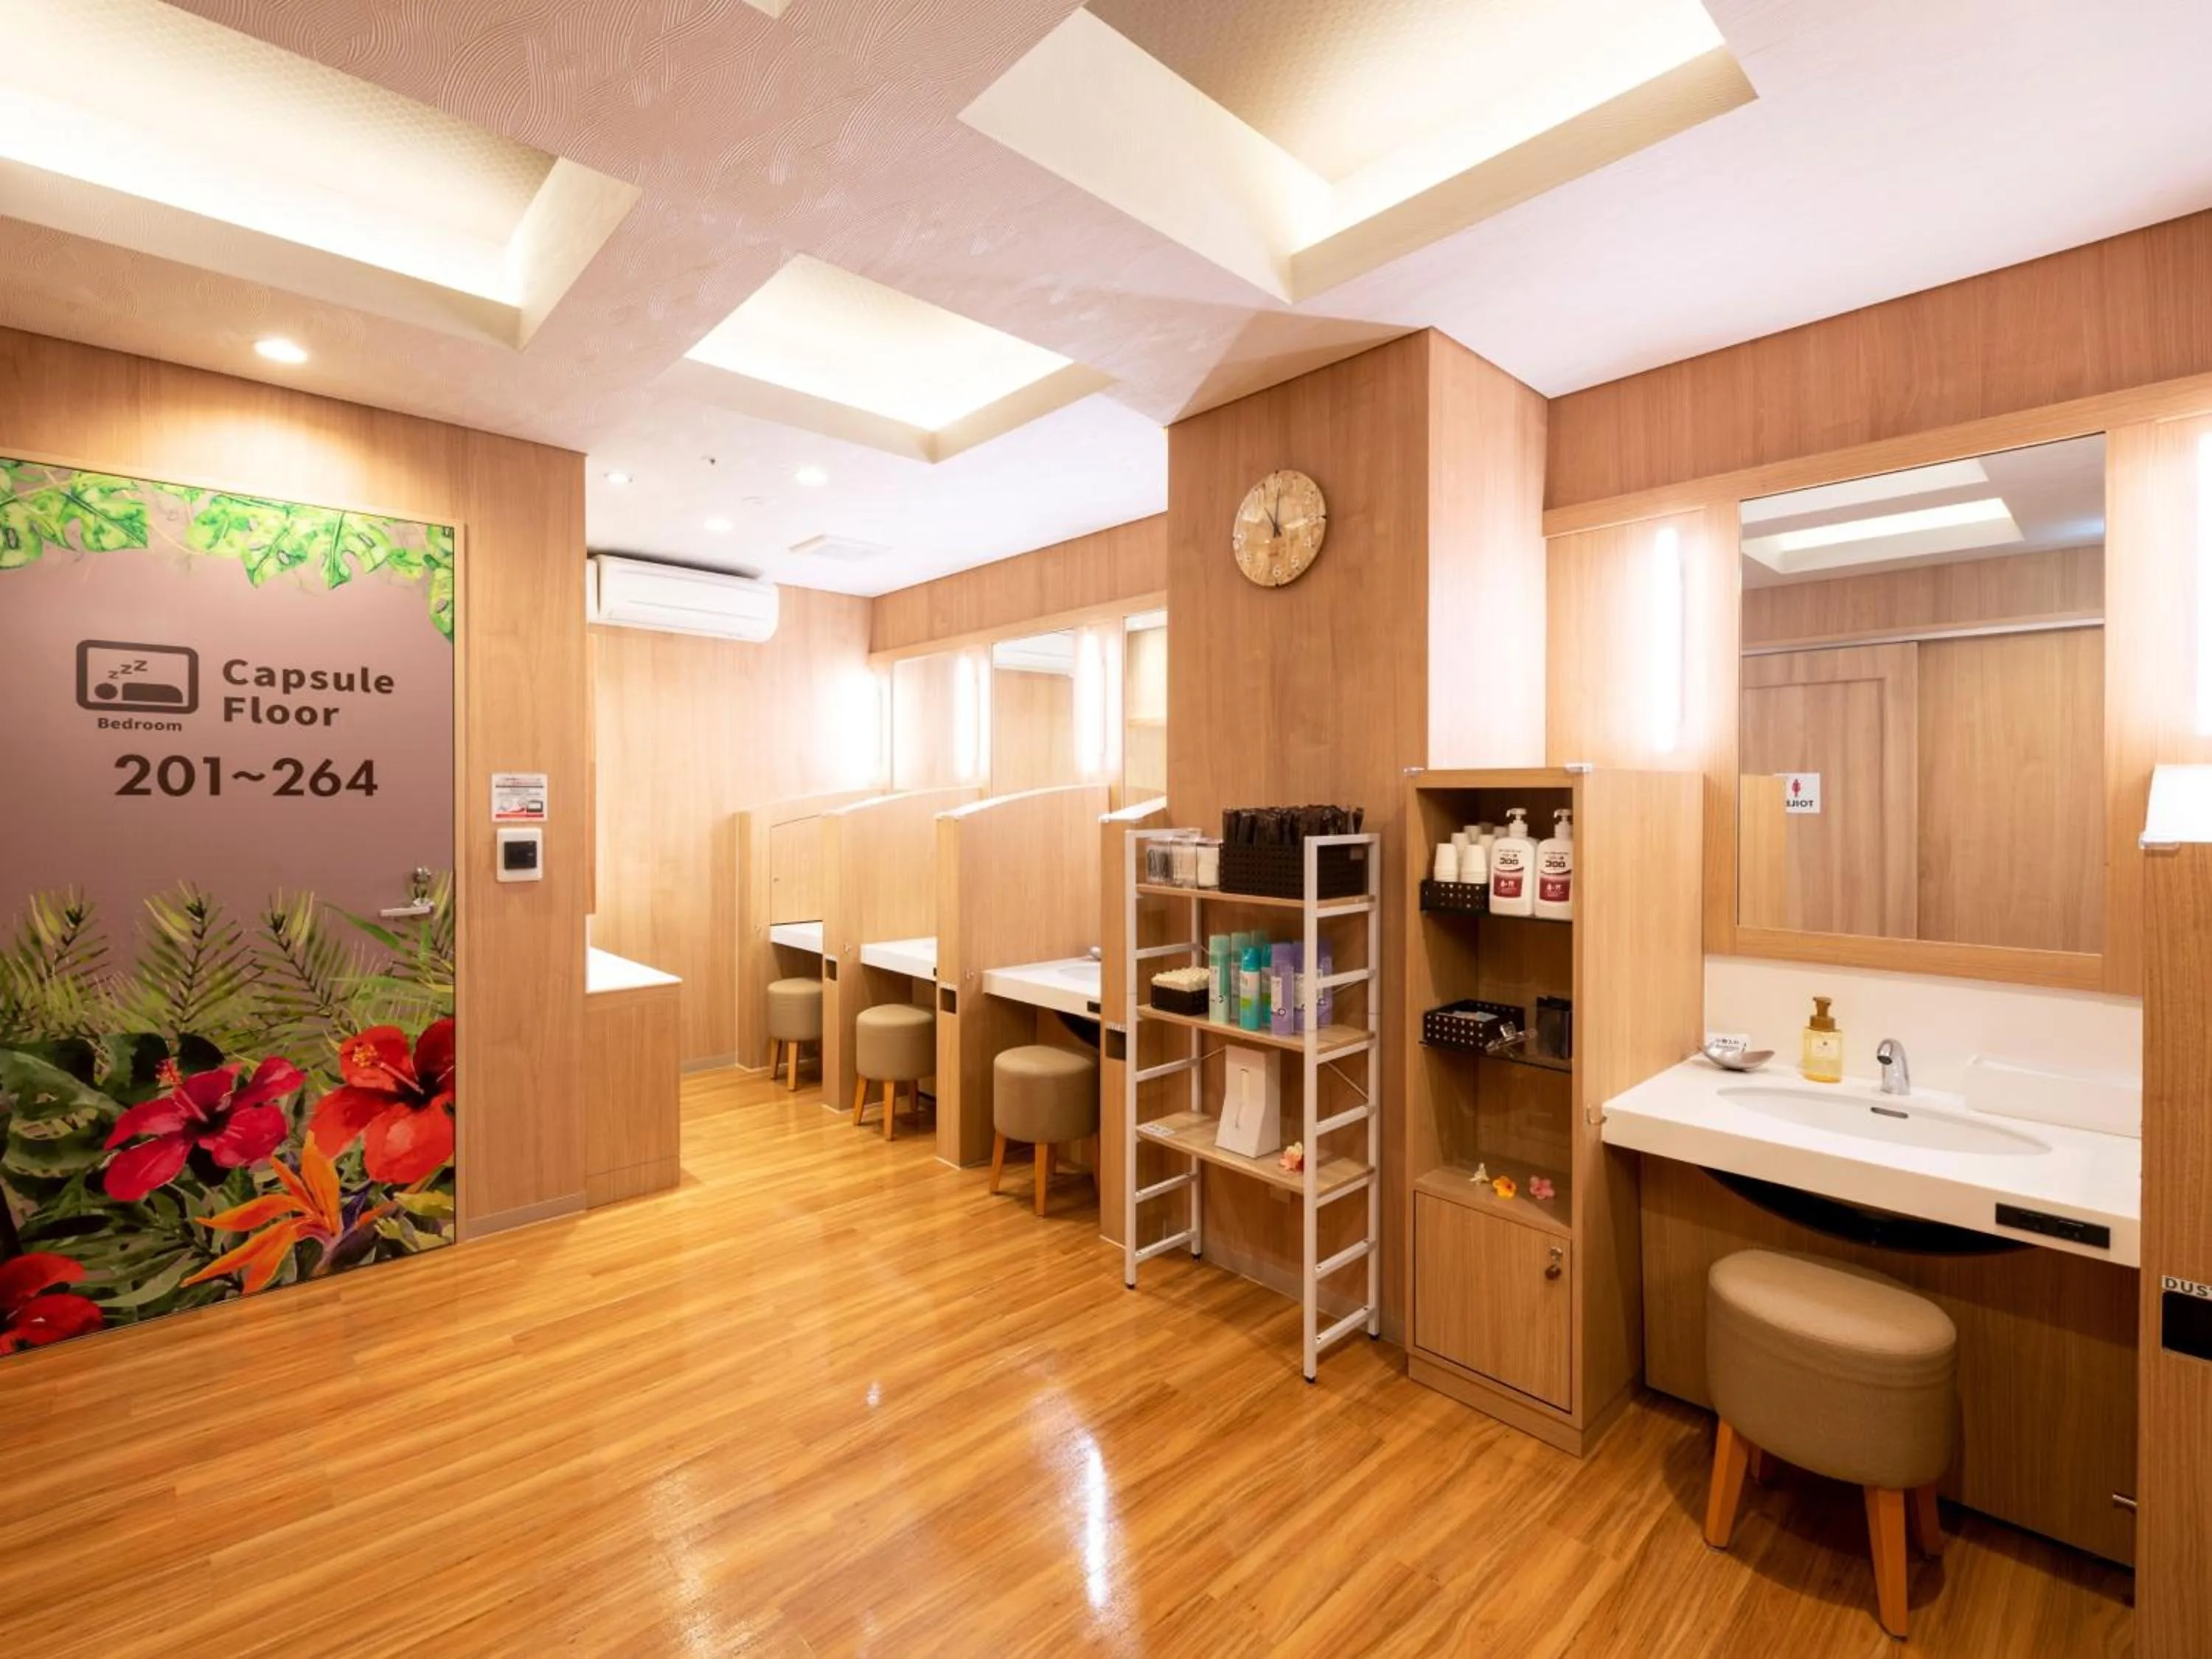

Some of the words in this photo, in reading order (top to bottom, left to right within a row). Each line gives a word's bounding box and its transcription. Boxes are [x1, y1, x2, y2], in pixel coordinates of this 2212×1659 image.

[223, 659, 395, 694] Capsule
[223, 696, 339, 726] Floor
[97, 717, 183, 731] Bedroom
[2166, 1278, 2212, 1296] DUS
